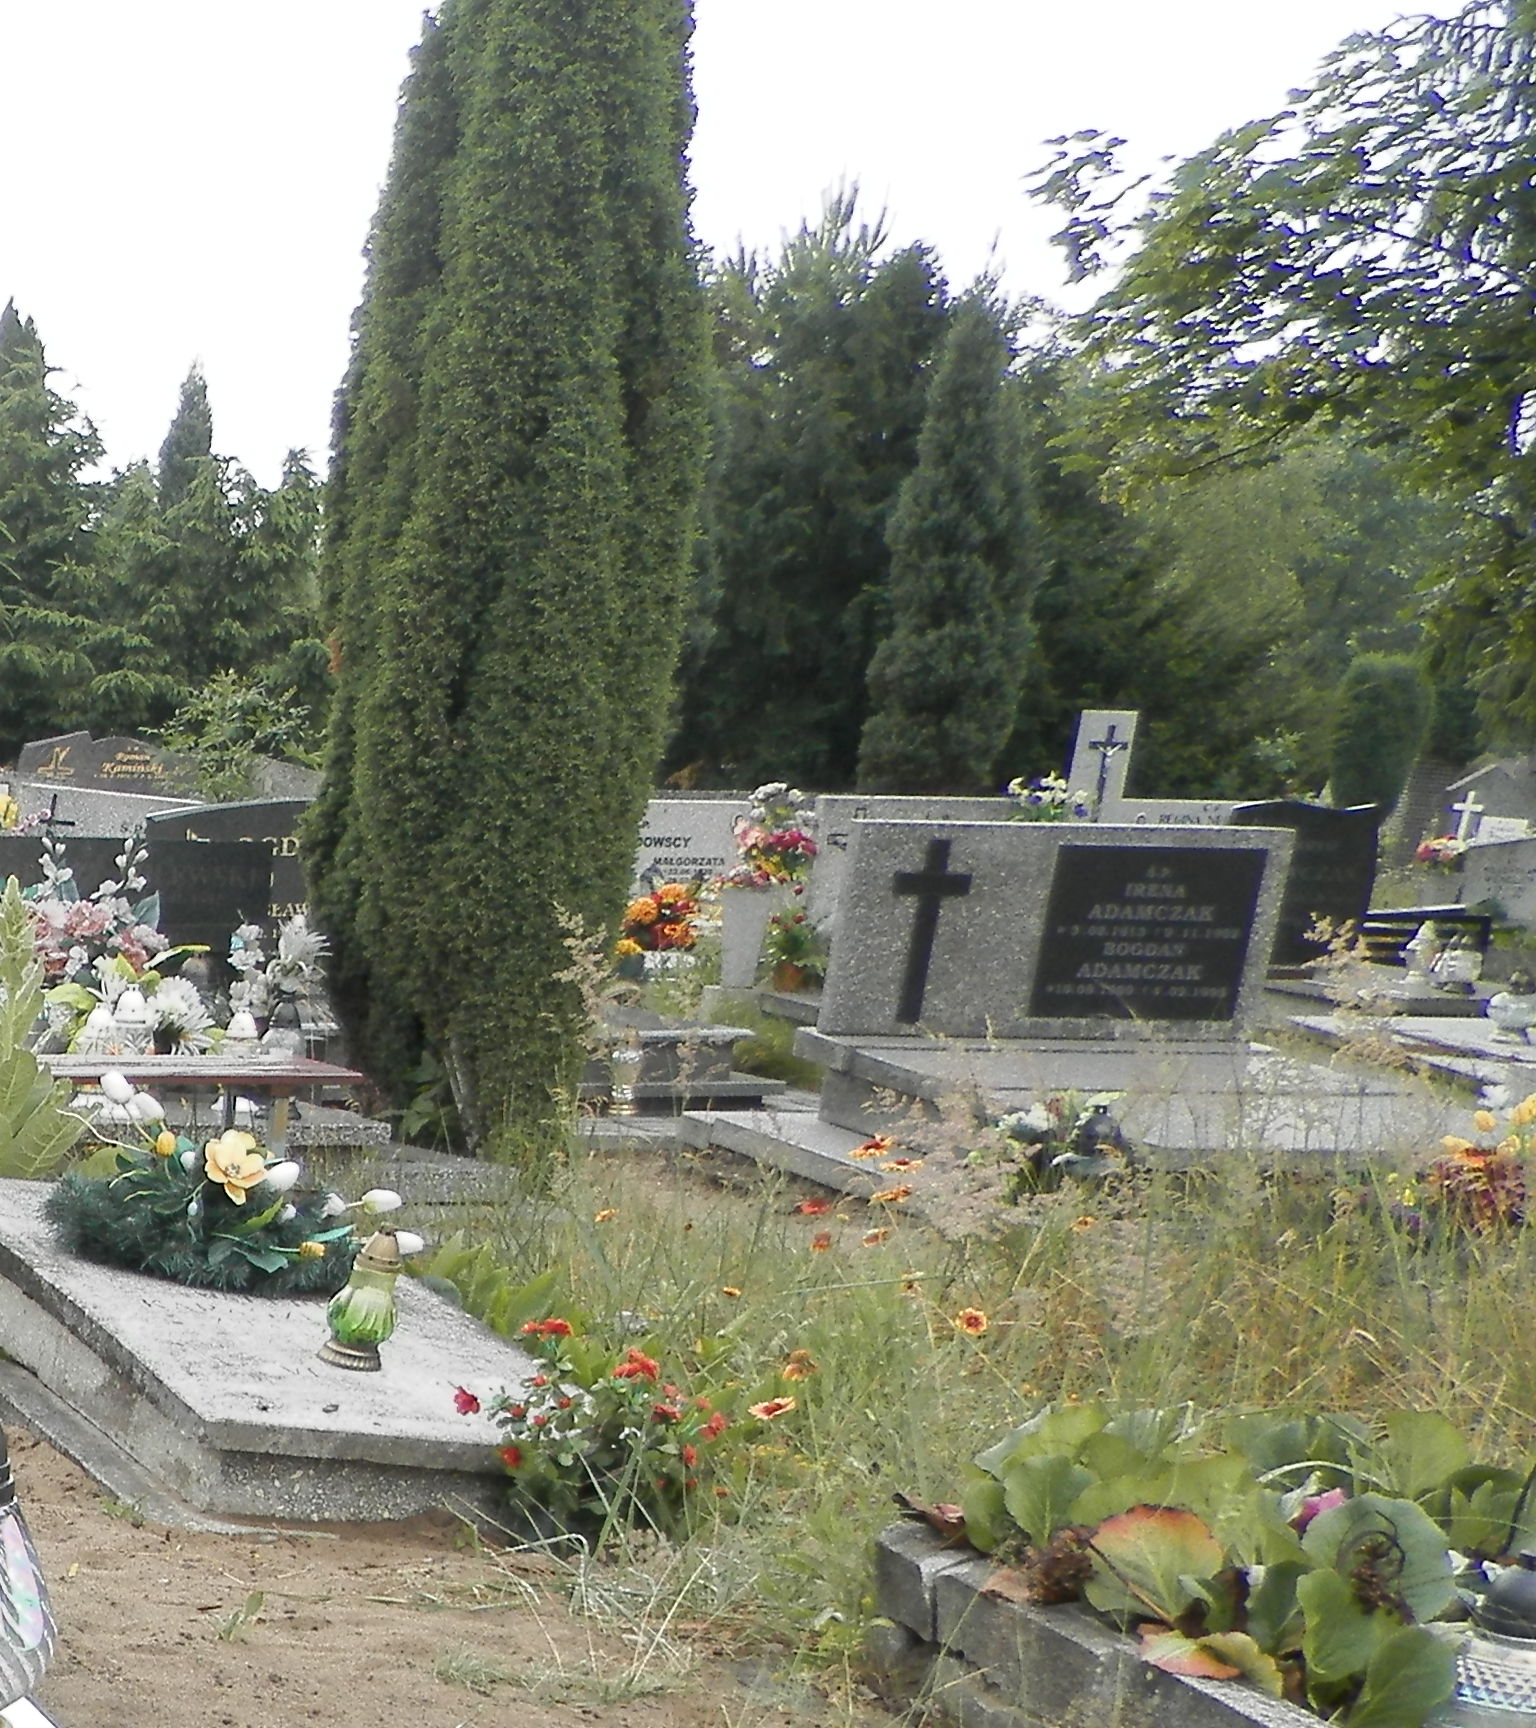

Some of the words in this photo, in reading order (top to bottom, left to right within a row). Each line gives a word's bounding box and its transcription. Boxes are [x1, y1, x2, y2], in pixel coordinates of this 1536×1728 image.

[639, 836, 692, 849] OWSCY
[1087, 904, 1217, 922] ADAMCZAK
[1076, 962, 1205, 981] ADAMCZAK
